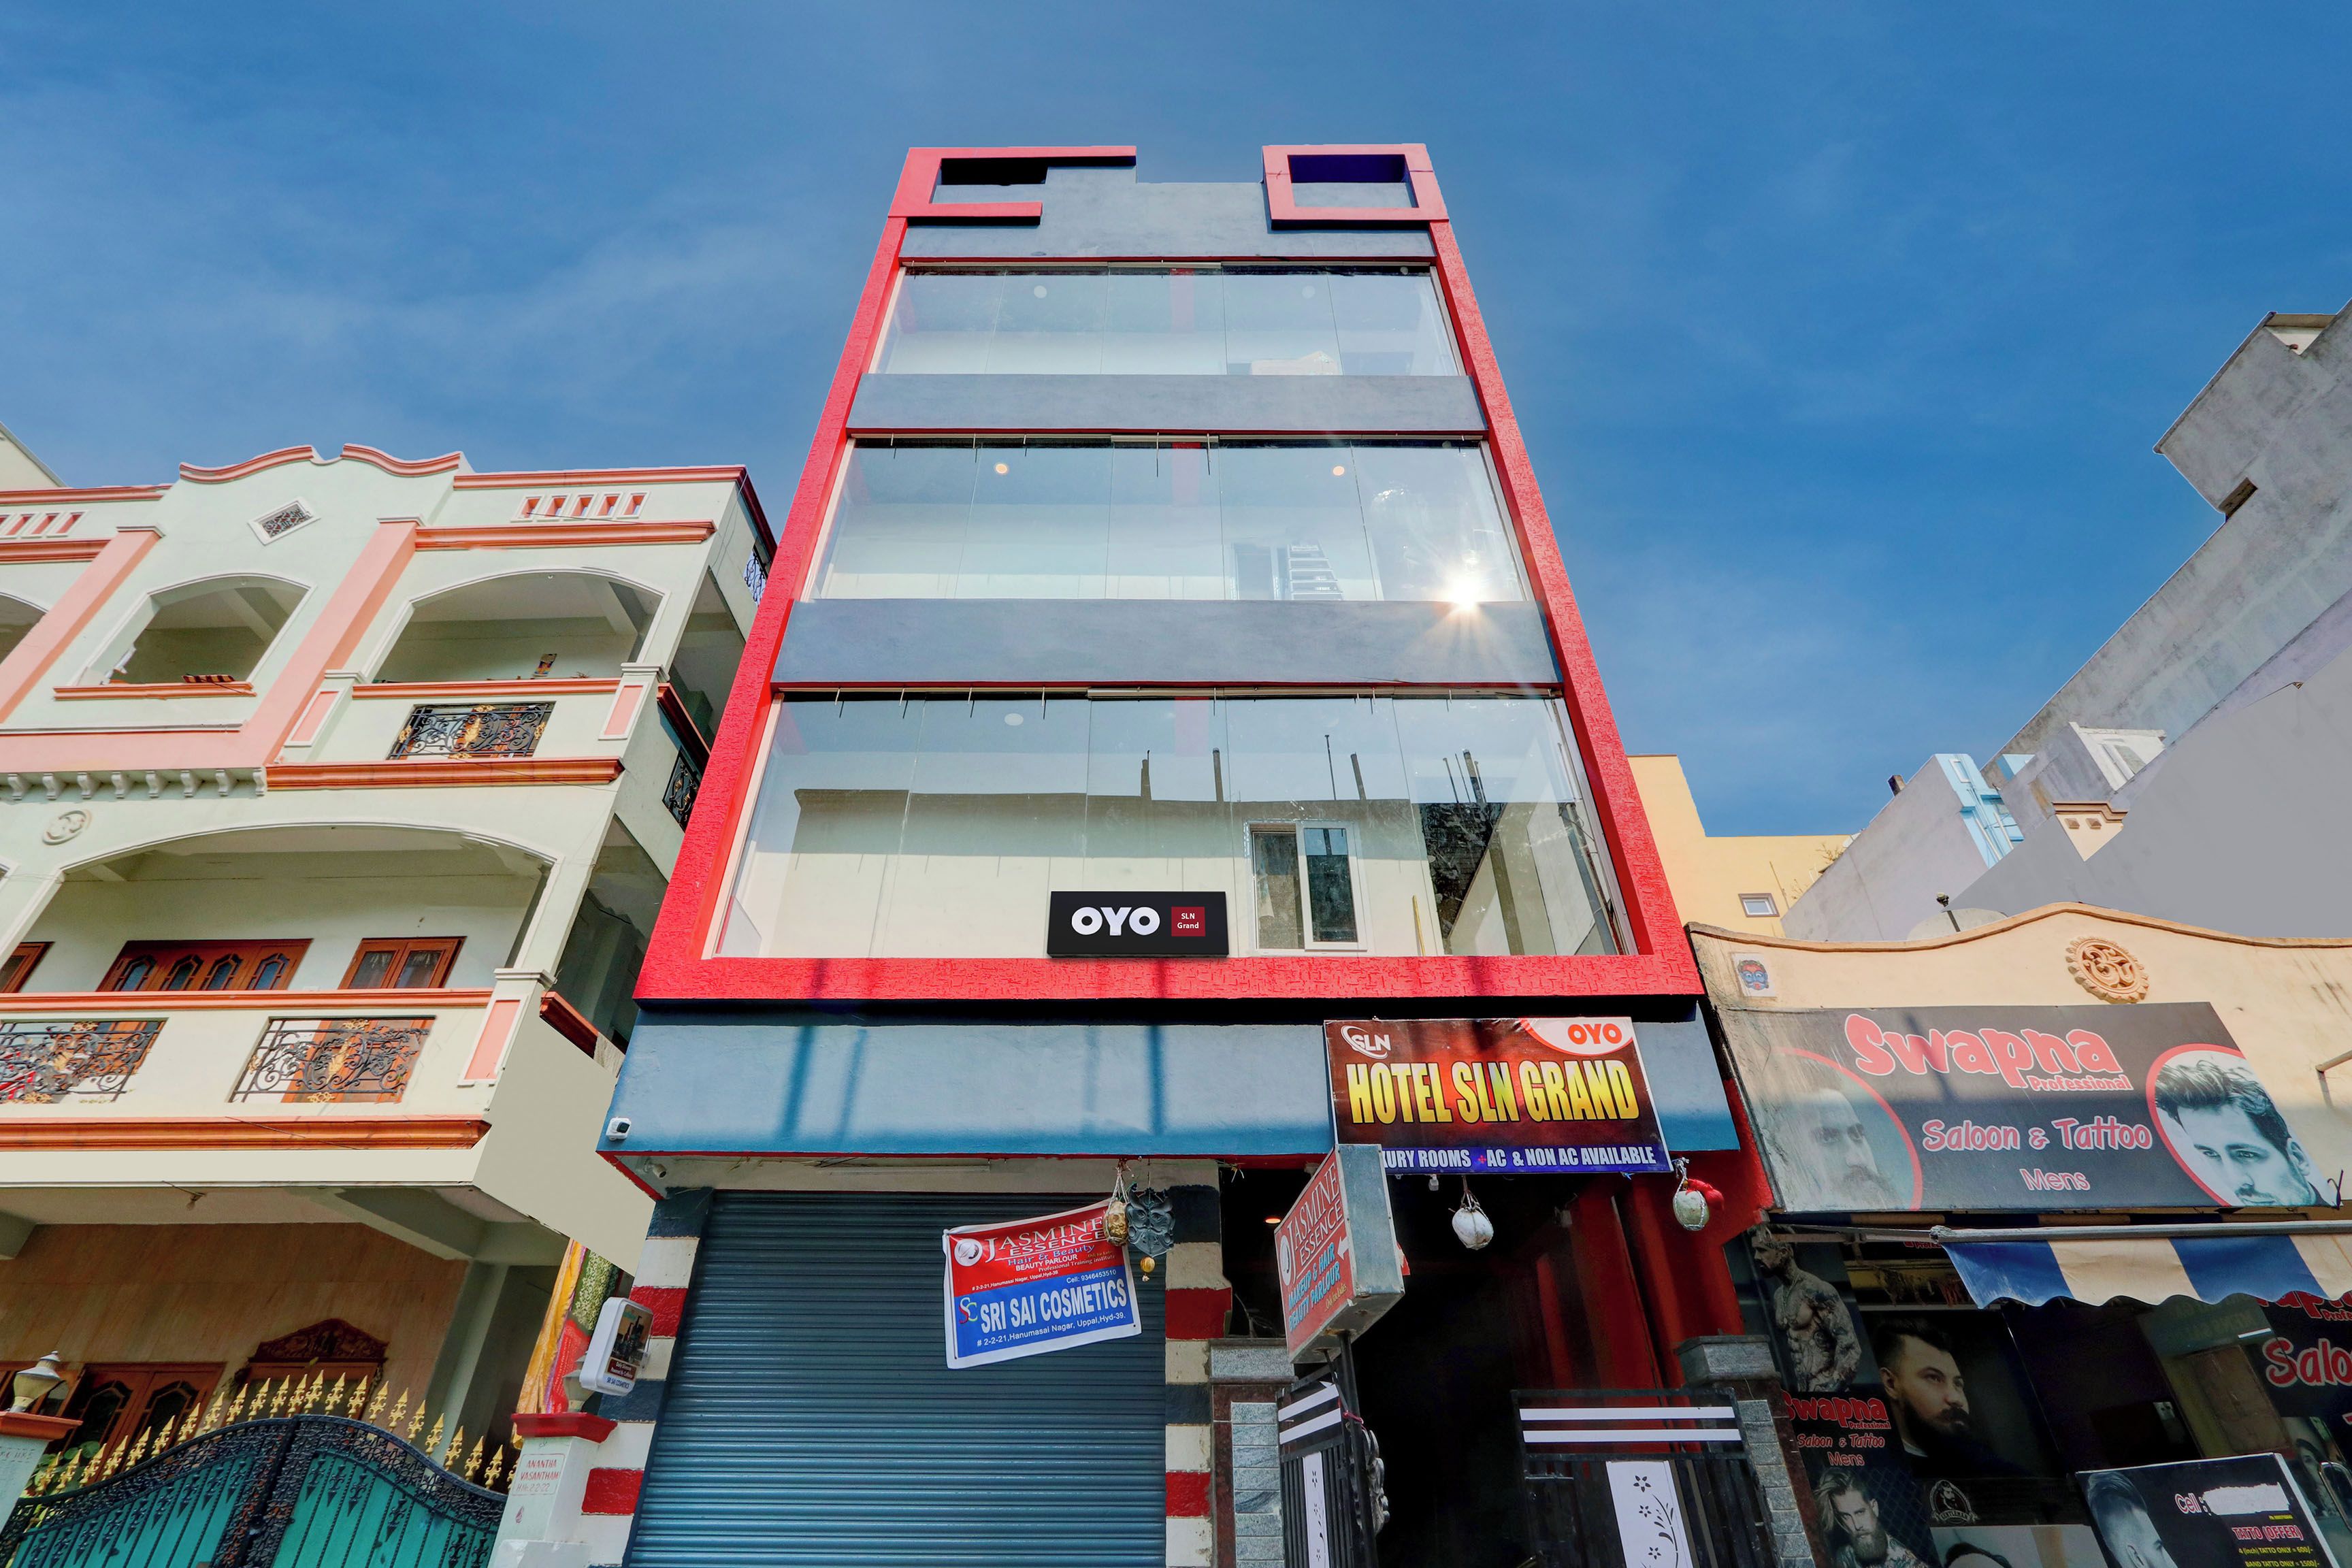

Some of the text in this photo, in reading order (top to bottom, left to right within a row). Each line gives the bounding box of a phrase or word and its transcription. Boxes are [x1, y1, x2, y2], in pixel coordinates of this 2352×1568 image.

[1071, 906, 1160, 936] OYO
[1351, 1034, 1391, 1051] SLN
[1568, 1023, 1622, 1045] OYO
[1845, 1013, 2123, 1088] Swapna
[1345, 1059, 1639, 1124] HOTEL SLN GRAND
[2027, 1075, 2134, 1092] Professional
[1923, 1115, 2153, 1152] Saloon & Tattoo
[1418, 1149, 1471, 1168] ROOMS
[1486, 1149, 1507, 1167] AC
[1512, 1151, 1524, 1166] &
[1524, 1147, 1556, 1166] NON
[1558, 1147, 1579, 1165] AC
[1580, 1146, 1656, 1165] AVAILABLE
[2019, 1169, 2091, 1190] Mens
[1287, 1162, 1340, 1284] JASMINE
[1300, 1198, 1343, 1266] ESSENCE
[985, 1216, 1103, 1263] JASMINE
[1009, 1231, 1106, 1257] ESSENCE
[1008, 1256, 1034, 1266] Hair
[1054, 1245, 1094, 1258] Beauty
[1015, 1254, 1077, 1271] BEAUTY PARLOUR
[1039, 1262, 1070, 1273] Professional
[1081, 1269, 1117, 1281] 9346453510
[1288, 1270, 1312, 1311] MAKEUP
[1319, 1242, 1335, 1275] HAIR
[980, 1278, 1127, 1333] SRI SAI COSMETICS
[1288, 1261, 1341, 1333] BEAUTY PARLOUR
[1051, 1322, 1075, 1332] Nagar,
[1848, 1421, 1891, 1429] Professional
[1797, 1433, 1885, 1448] Saloon & Tattoo
[1827, 1452, 1865, 1466] Mens
[2174, 1492, 2202, 1514] Cell
[2232, 1525, 2304, 1541] TATTO (OFFER)
